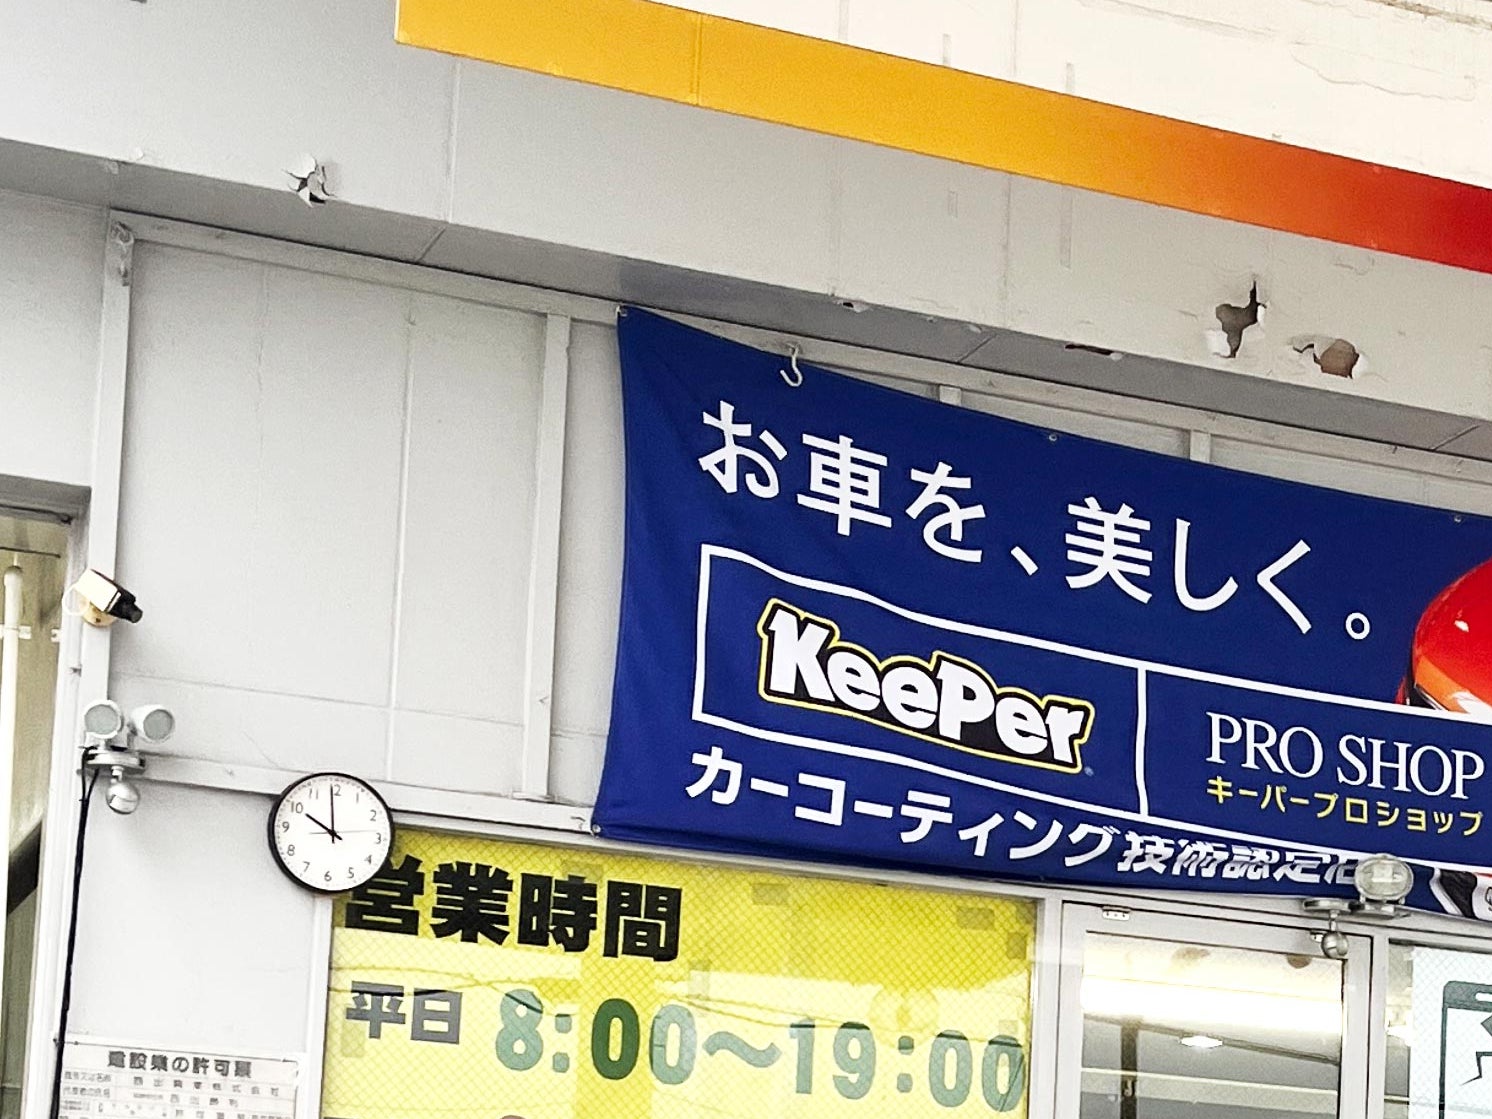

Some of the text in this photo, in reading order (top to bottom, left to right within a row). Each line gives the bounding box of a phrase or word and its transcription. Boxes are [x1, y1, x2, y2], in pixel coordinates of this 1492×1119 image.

[699, 400, 1371, 640] お車を、美しく。
[763, 604, 1091, 769] KeePer
[1206, 711, 1485, 800] PRO SHOP
[1206, 776, 1484, 836] キーパープロショップ
[344, 855, 684, 963] 営業時間
[346, 980, 463, 1046] 平日
